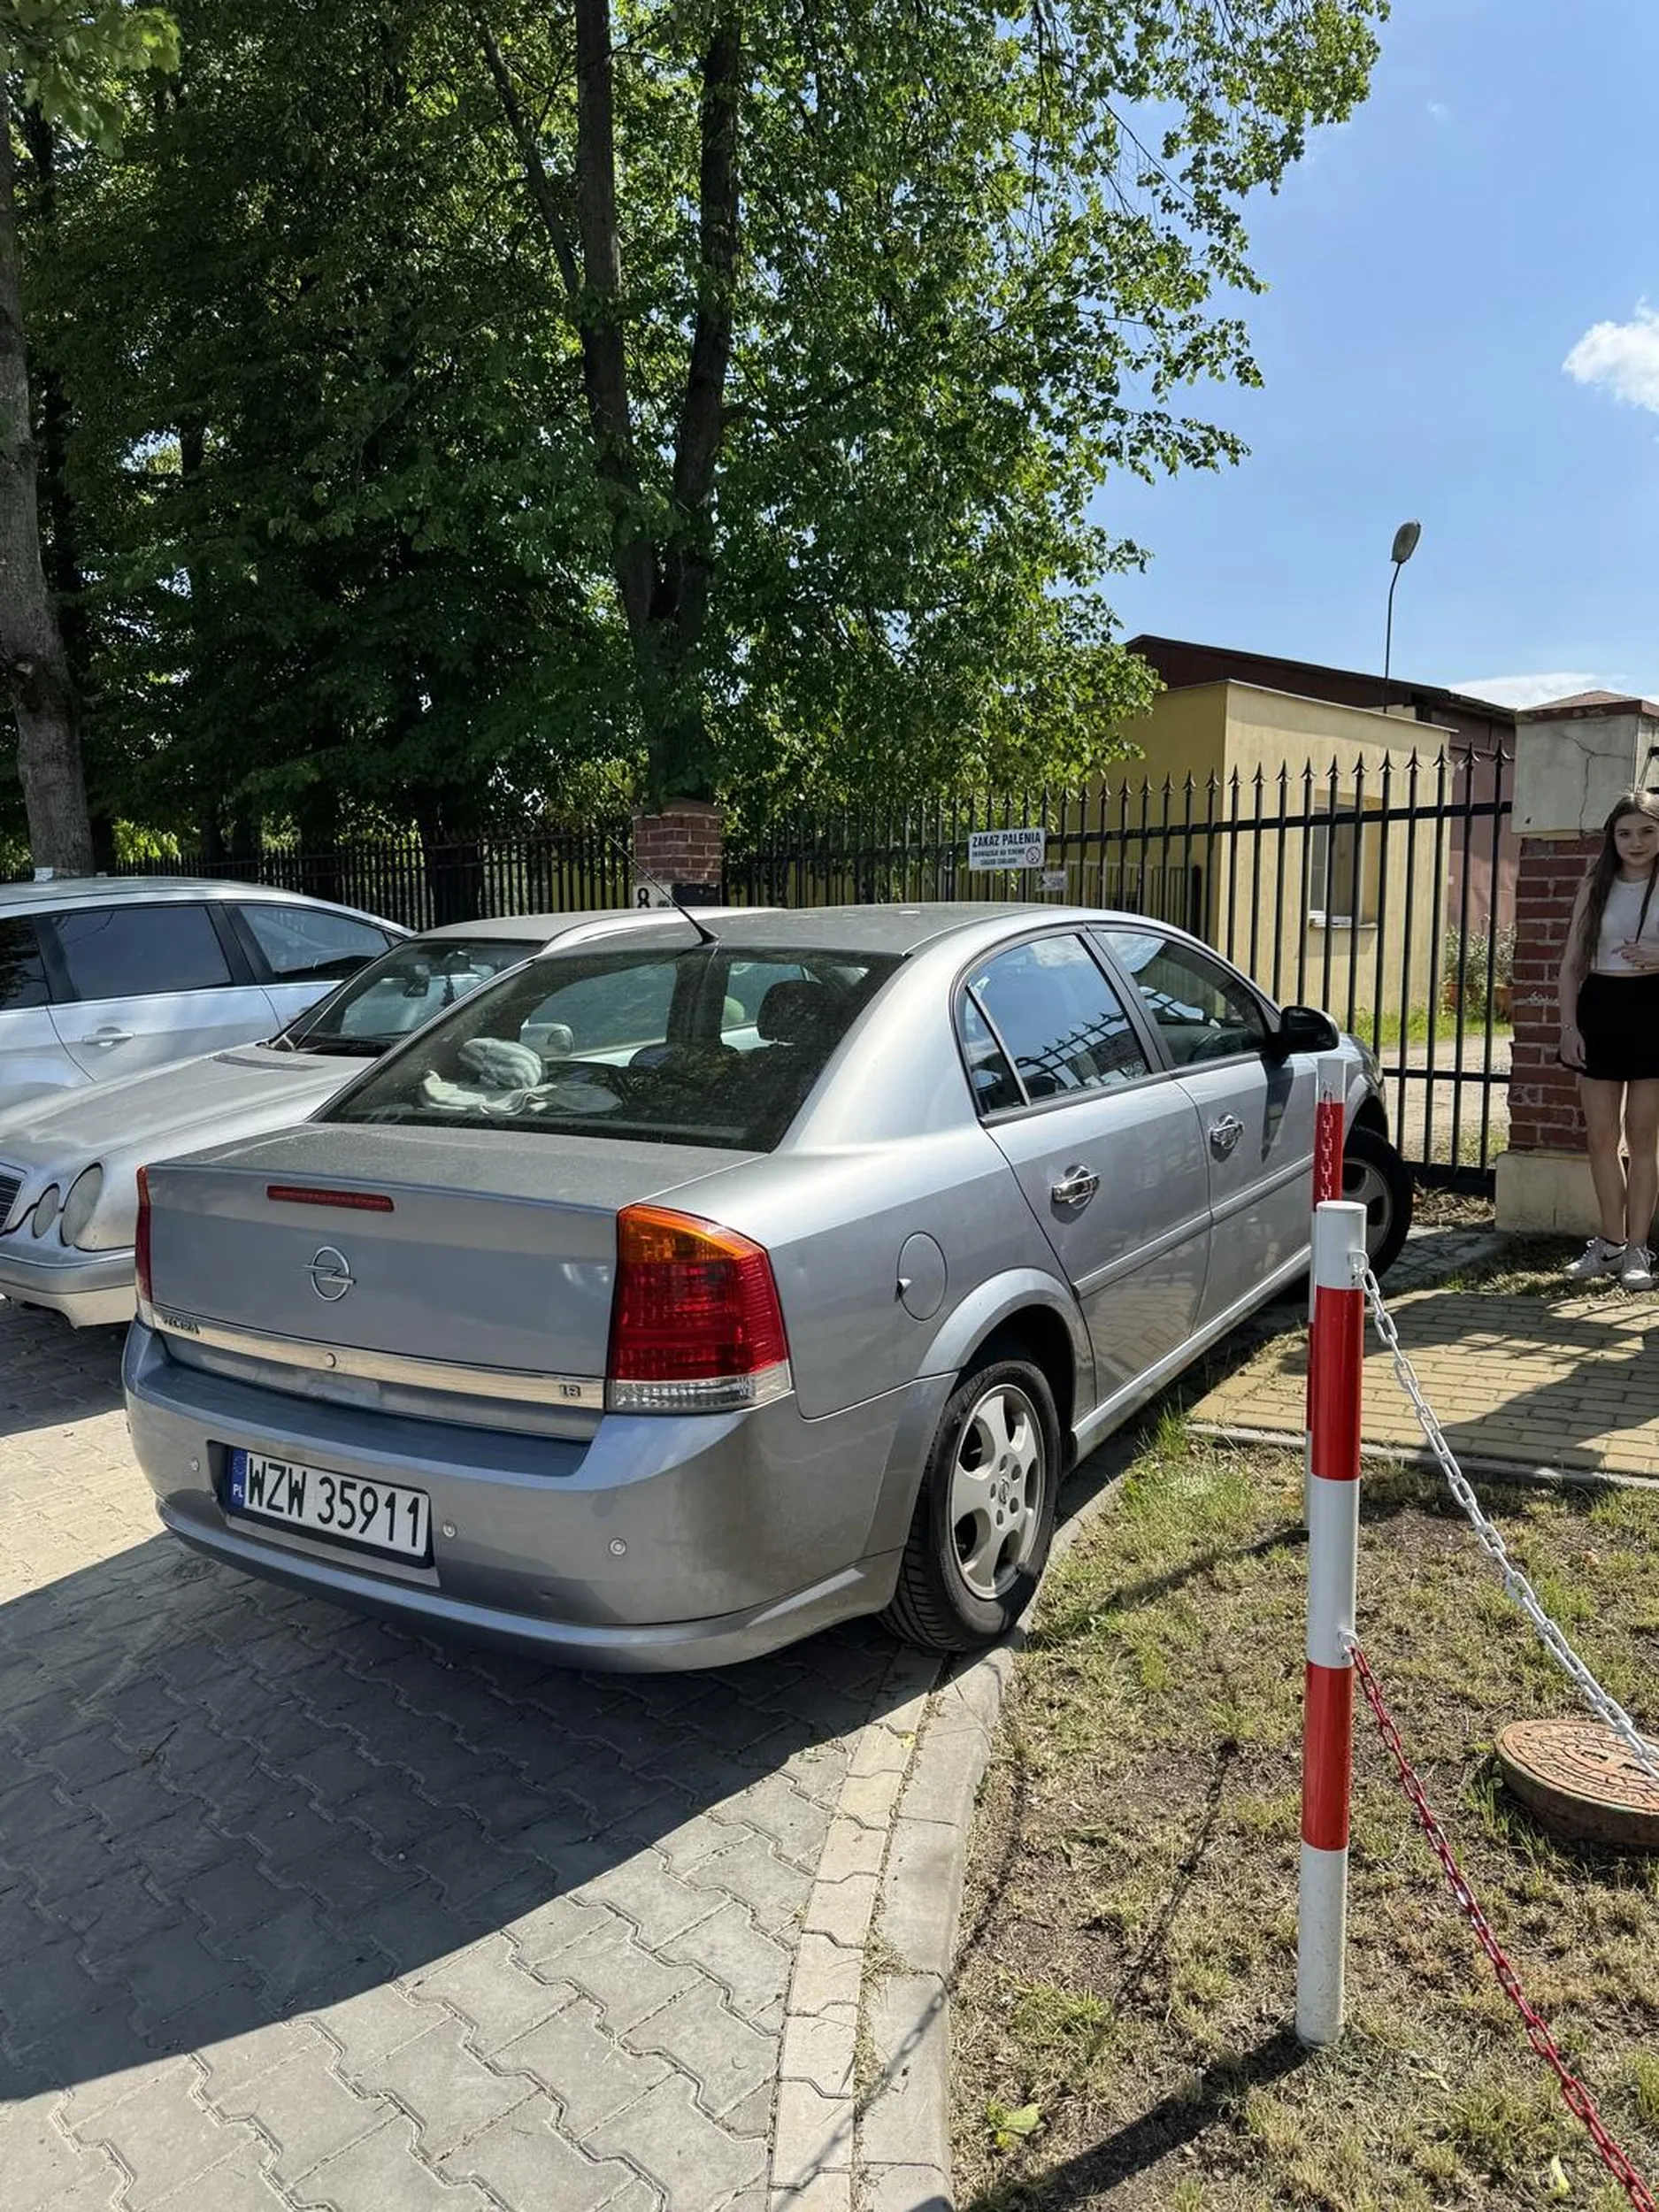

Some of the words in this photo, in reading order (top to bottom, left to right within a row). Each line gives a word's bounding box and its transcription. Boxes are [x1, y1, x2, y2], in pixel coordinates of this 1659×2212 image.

[972, 835, 1000, 848] ZAKAZ
[1002, 832, 1041, 846] PALENIA
[233, 1484, 244, 1498] PL
[249, 1457, 307, 1518] WZW
[317, 1476, 419, 1548] 35911
